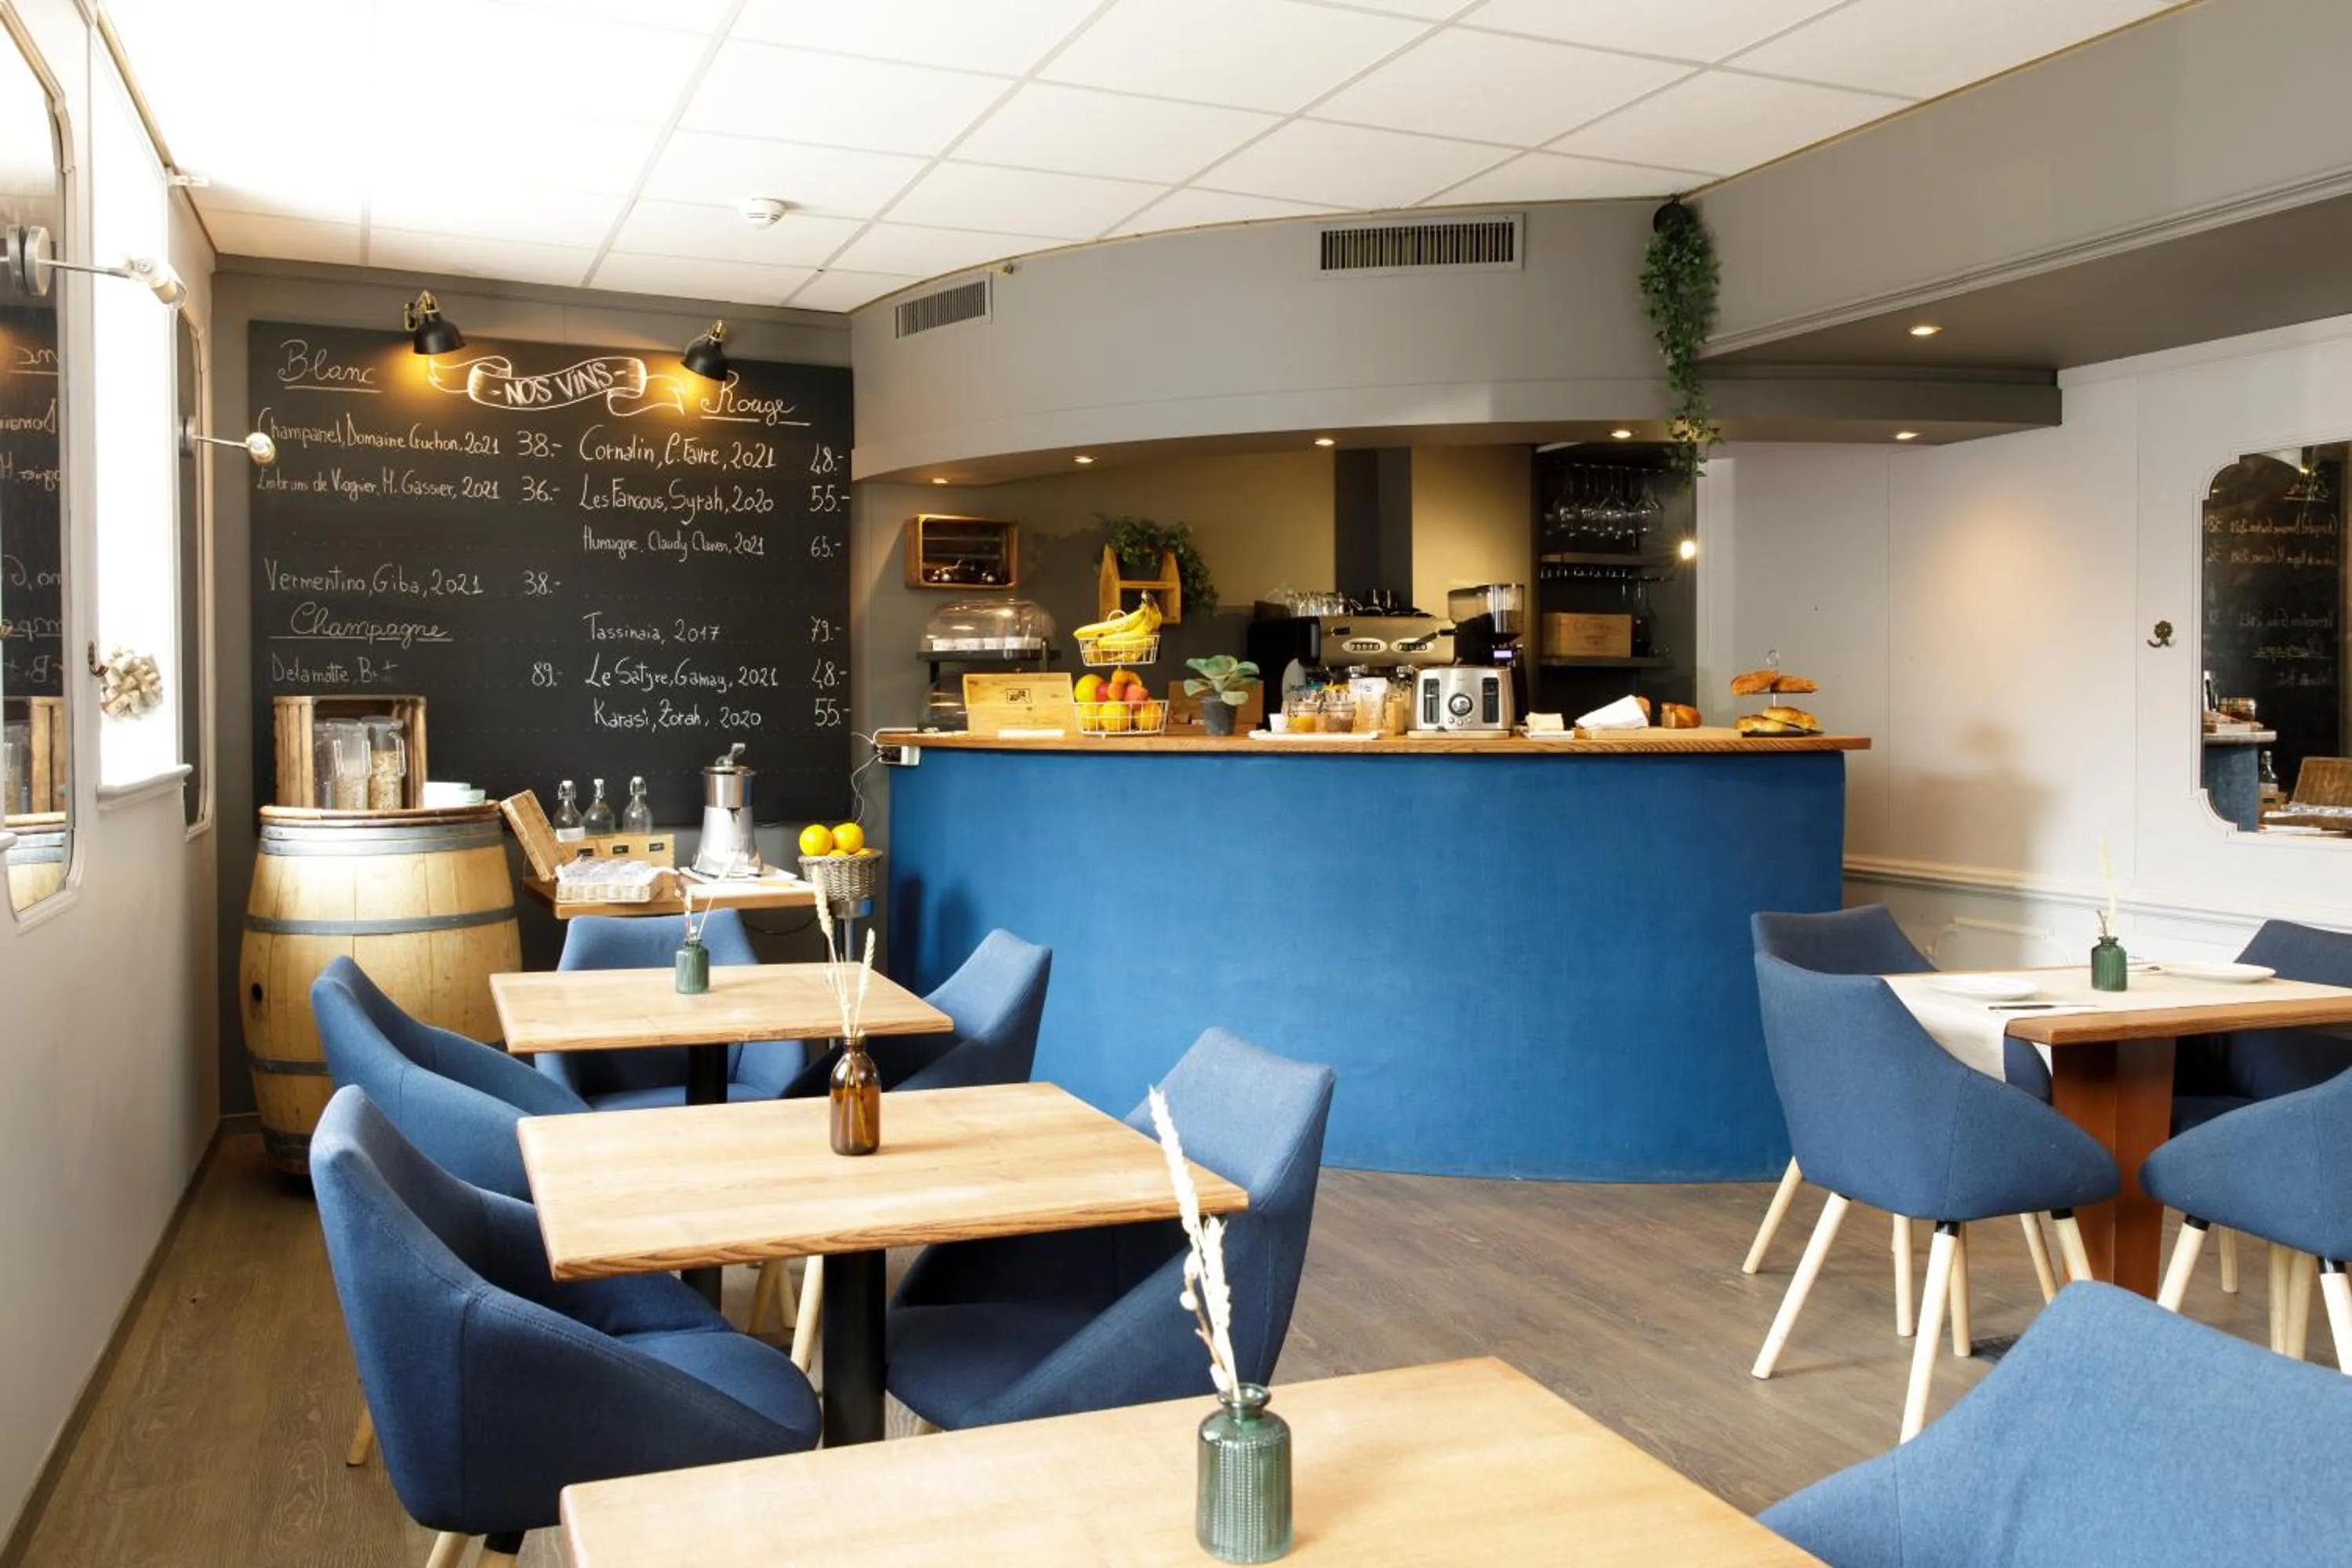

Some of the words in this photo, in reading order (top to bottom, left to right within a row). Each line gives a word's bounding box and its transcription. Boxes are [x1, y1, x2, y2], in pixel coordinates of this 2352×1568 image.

[278, 339, 376, 384] Blanc
[701, 369, 796, 426] Rouge
[347, 412, 405, 448] Domaine
[464, 431, 501, 455] 2021
[731, 441, 778, 469] 2021
[462, 475, 501, 499] 2021
[579, 473, 610, 510] Les
[731, 485, 774, 513] 2020
[735, 532, 765, 555] 2021
[430, 568, 485, 596] 2021
[290, 601, 449, 649] Champagne
[674, 619, 720, 641] 2017
[585, 652, 611, 688] Le
[739, 667, 779, 687] 2021
[720, 706, 761, 728] 2020
